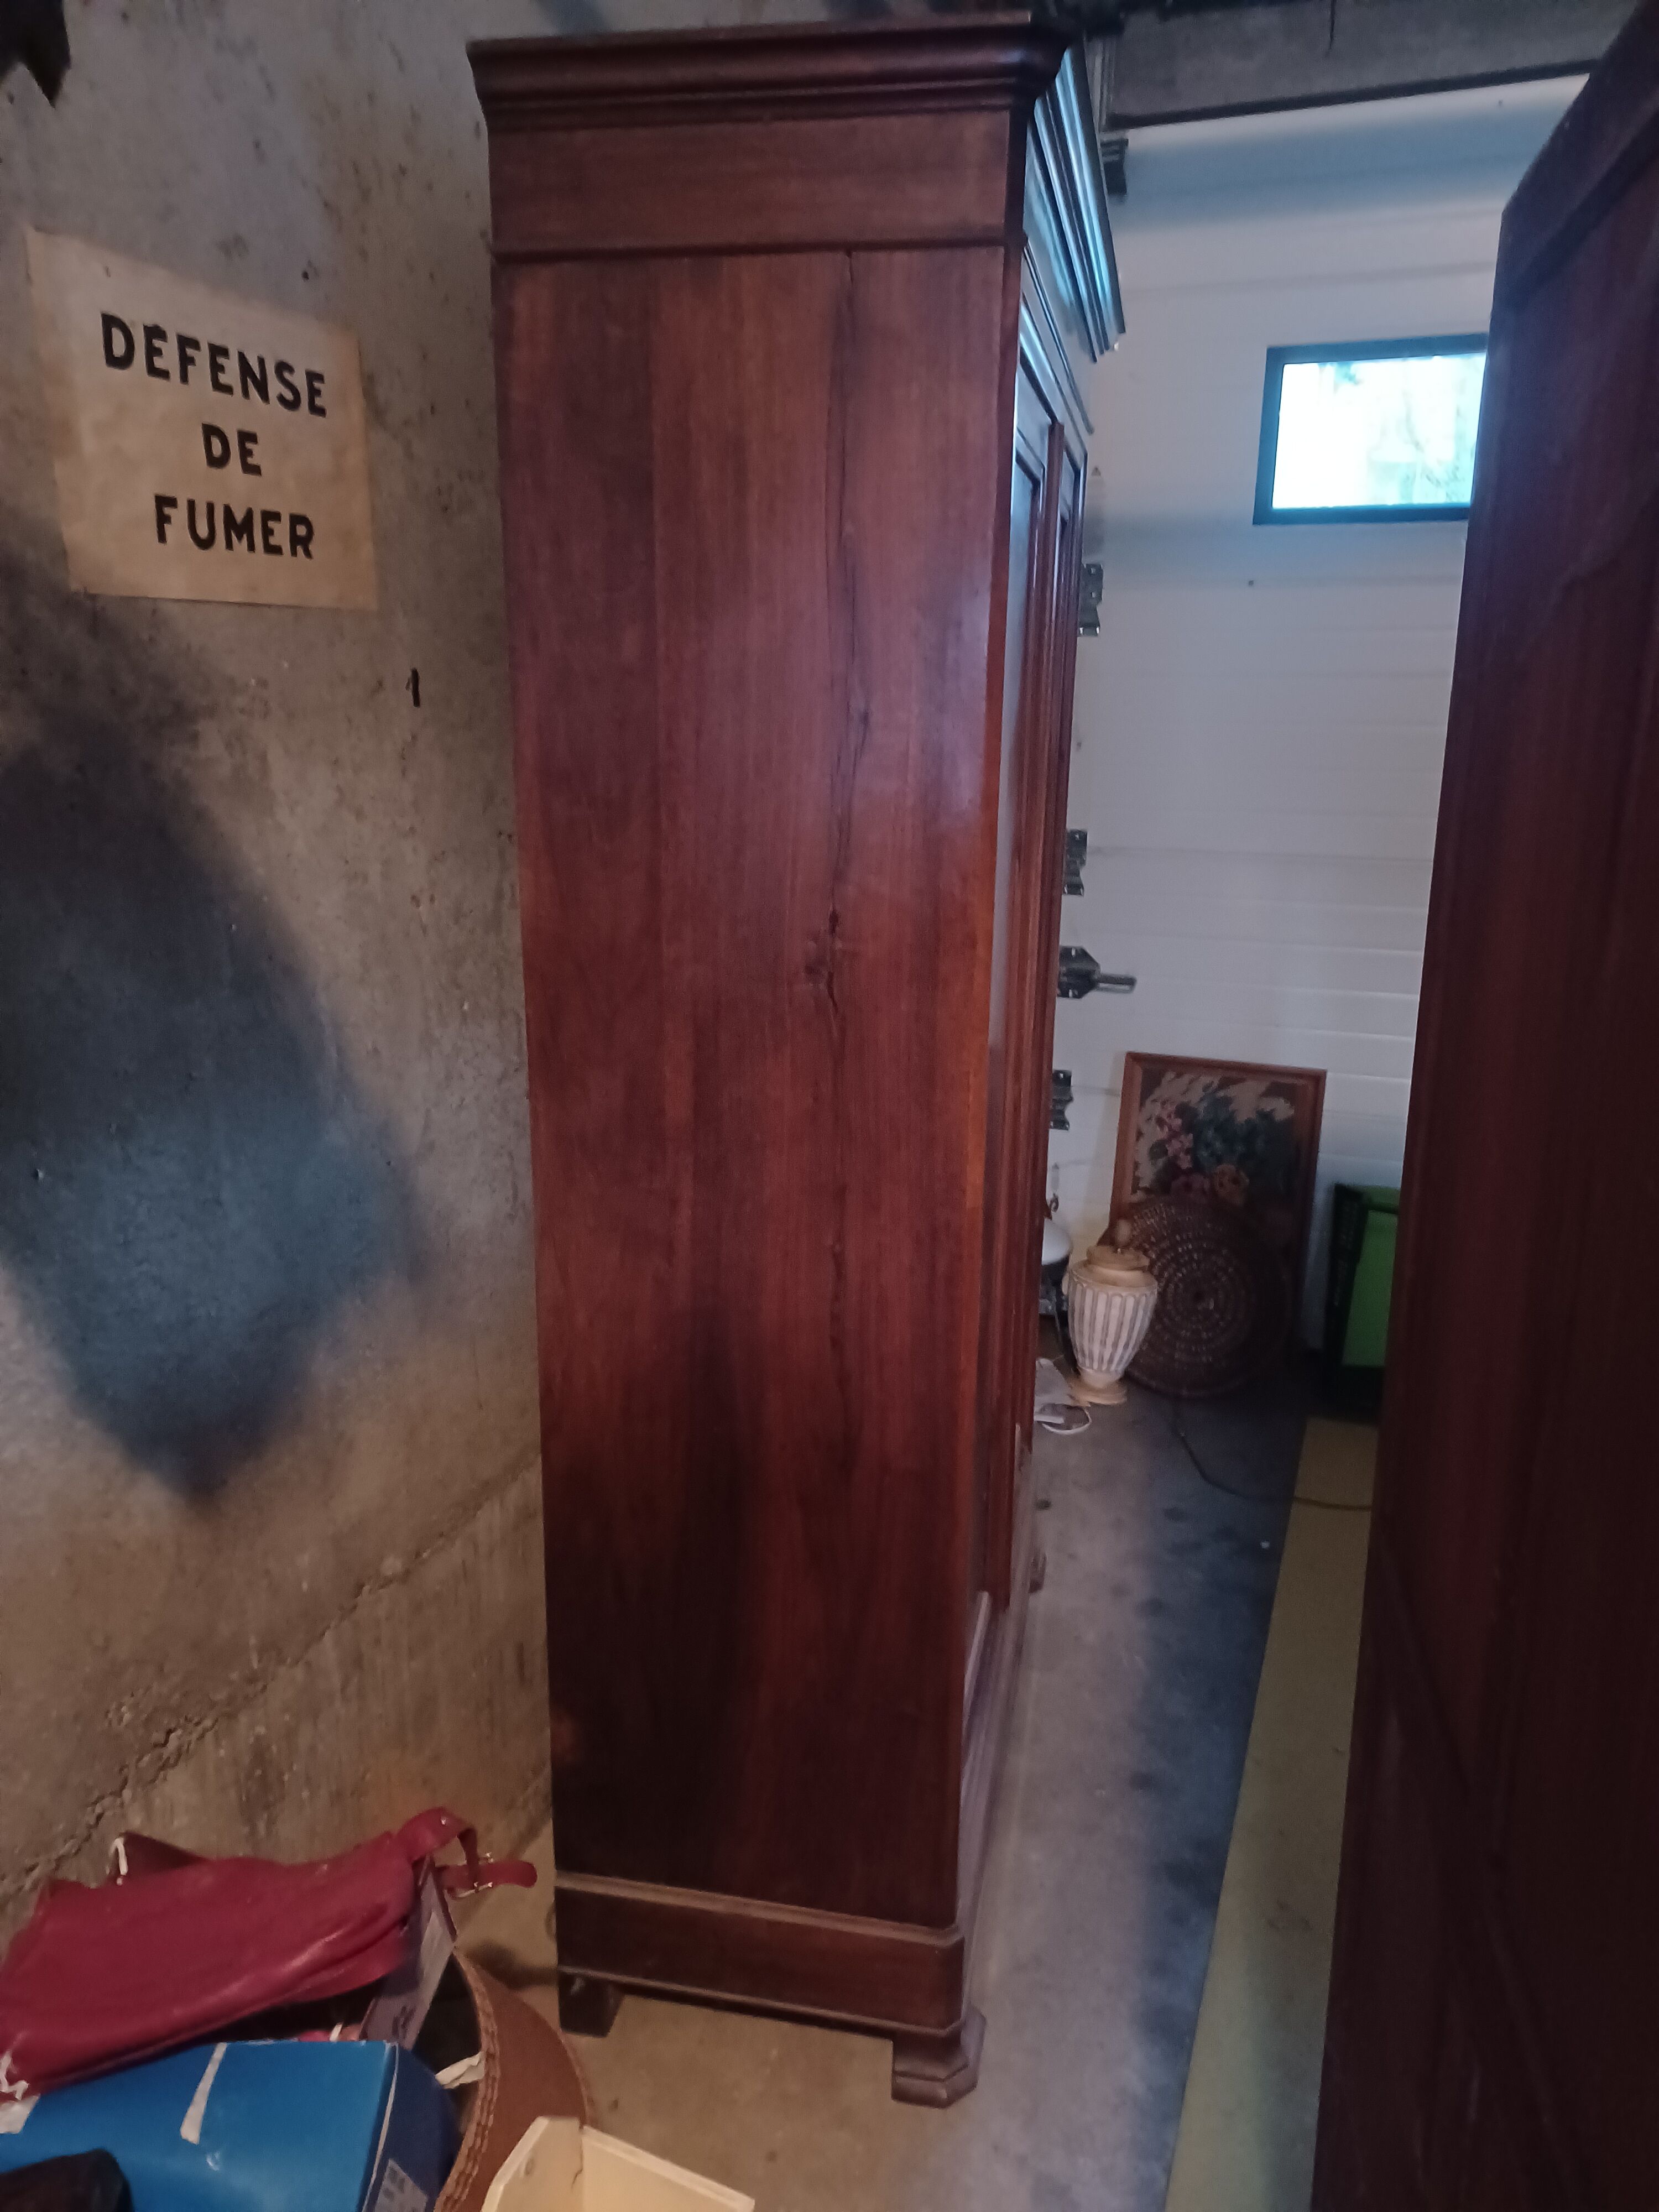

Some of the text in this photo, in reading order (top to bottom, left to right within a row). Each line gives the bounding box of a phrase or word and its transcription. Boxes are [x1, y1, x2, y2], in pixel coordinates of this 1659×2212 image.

[101, 312, 327, 418] DEFENSE
[201, 422, 262, 477] DE
[154, 494, 315, 560] FUMER
